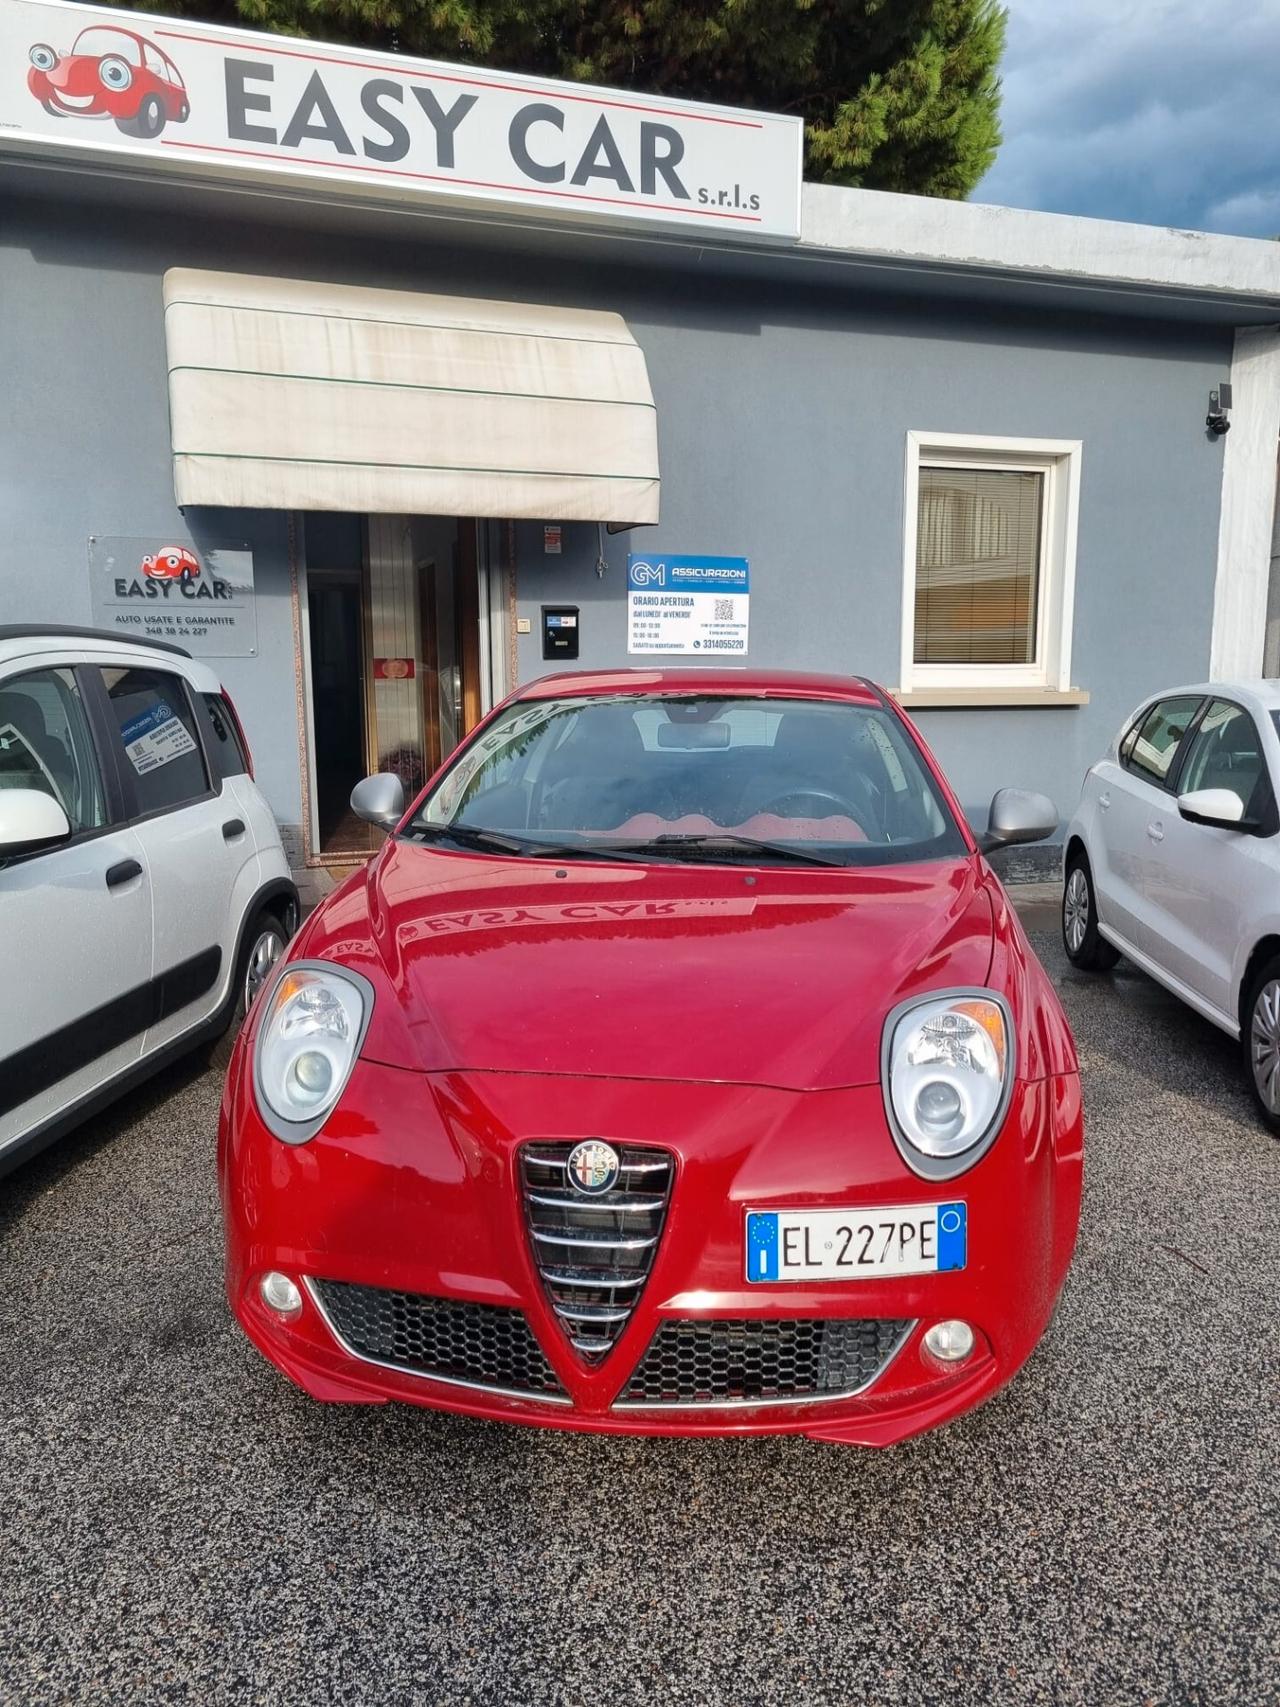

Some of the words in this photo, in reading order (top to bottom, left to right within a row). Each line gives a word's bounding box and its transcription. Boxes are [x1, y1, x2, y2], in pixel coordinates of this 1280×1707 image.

[224, 57, 479, 169] EASY
[508, 102, 692, 200] CAR
[698, 184, 760, 210] s.r.l.s
[630, 562, 665, 586] GM
[671, 567, 746, 578] ASSICURAZIONI
[114, 578, 173, 600] EASY
[180, 578, 229, 600] CAR
[633, 596, 659, 606] ORARIO
[660, 597, 695, 606] APERTURA
[115, 615, 141, 624] AUTO
[144, 616, 173, 625] USATE
[176, 616, 182, 624] E
[185, 616, 235, 625] GARANTITE
[145, 627, 162, 635] 348
[192, 628, 208, 636] 227
[703, 639, 744, 649] 3314055220
[783, 1226, 823, 1267] EL
[836, 1220, 936, 1266] 227PE
[760, 1250, 767, 1274] I
